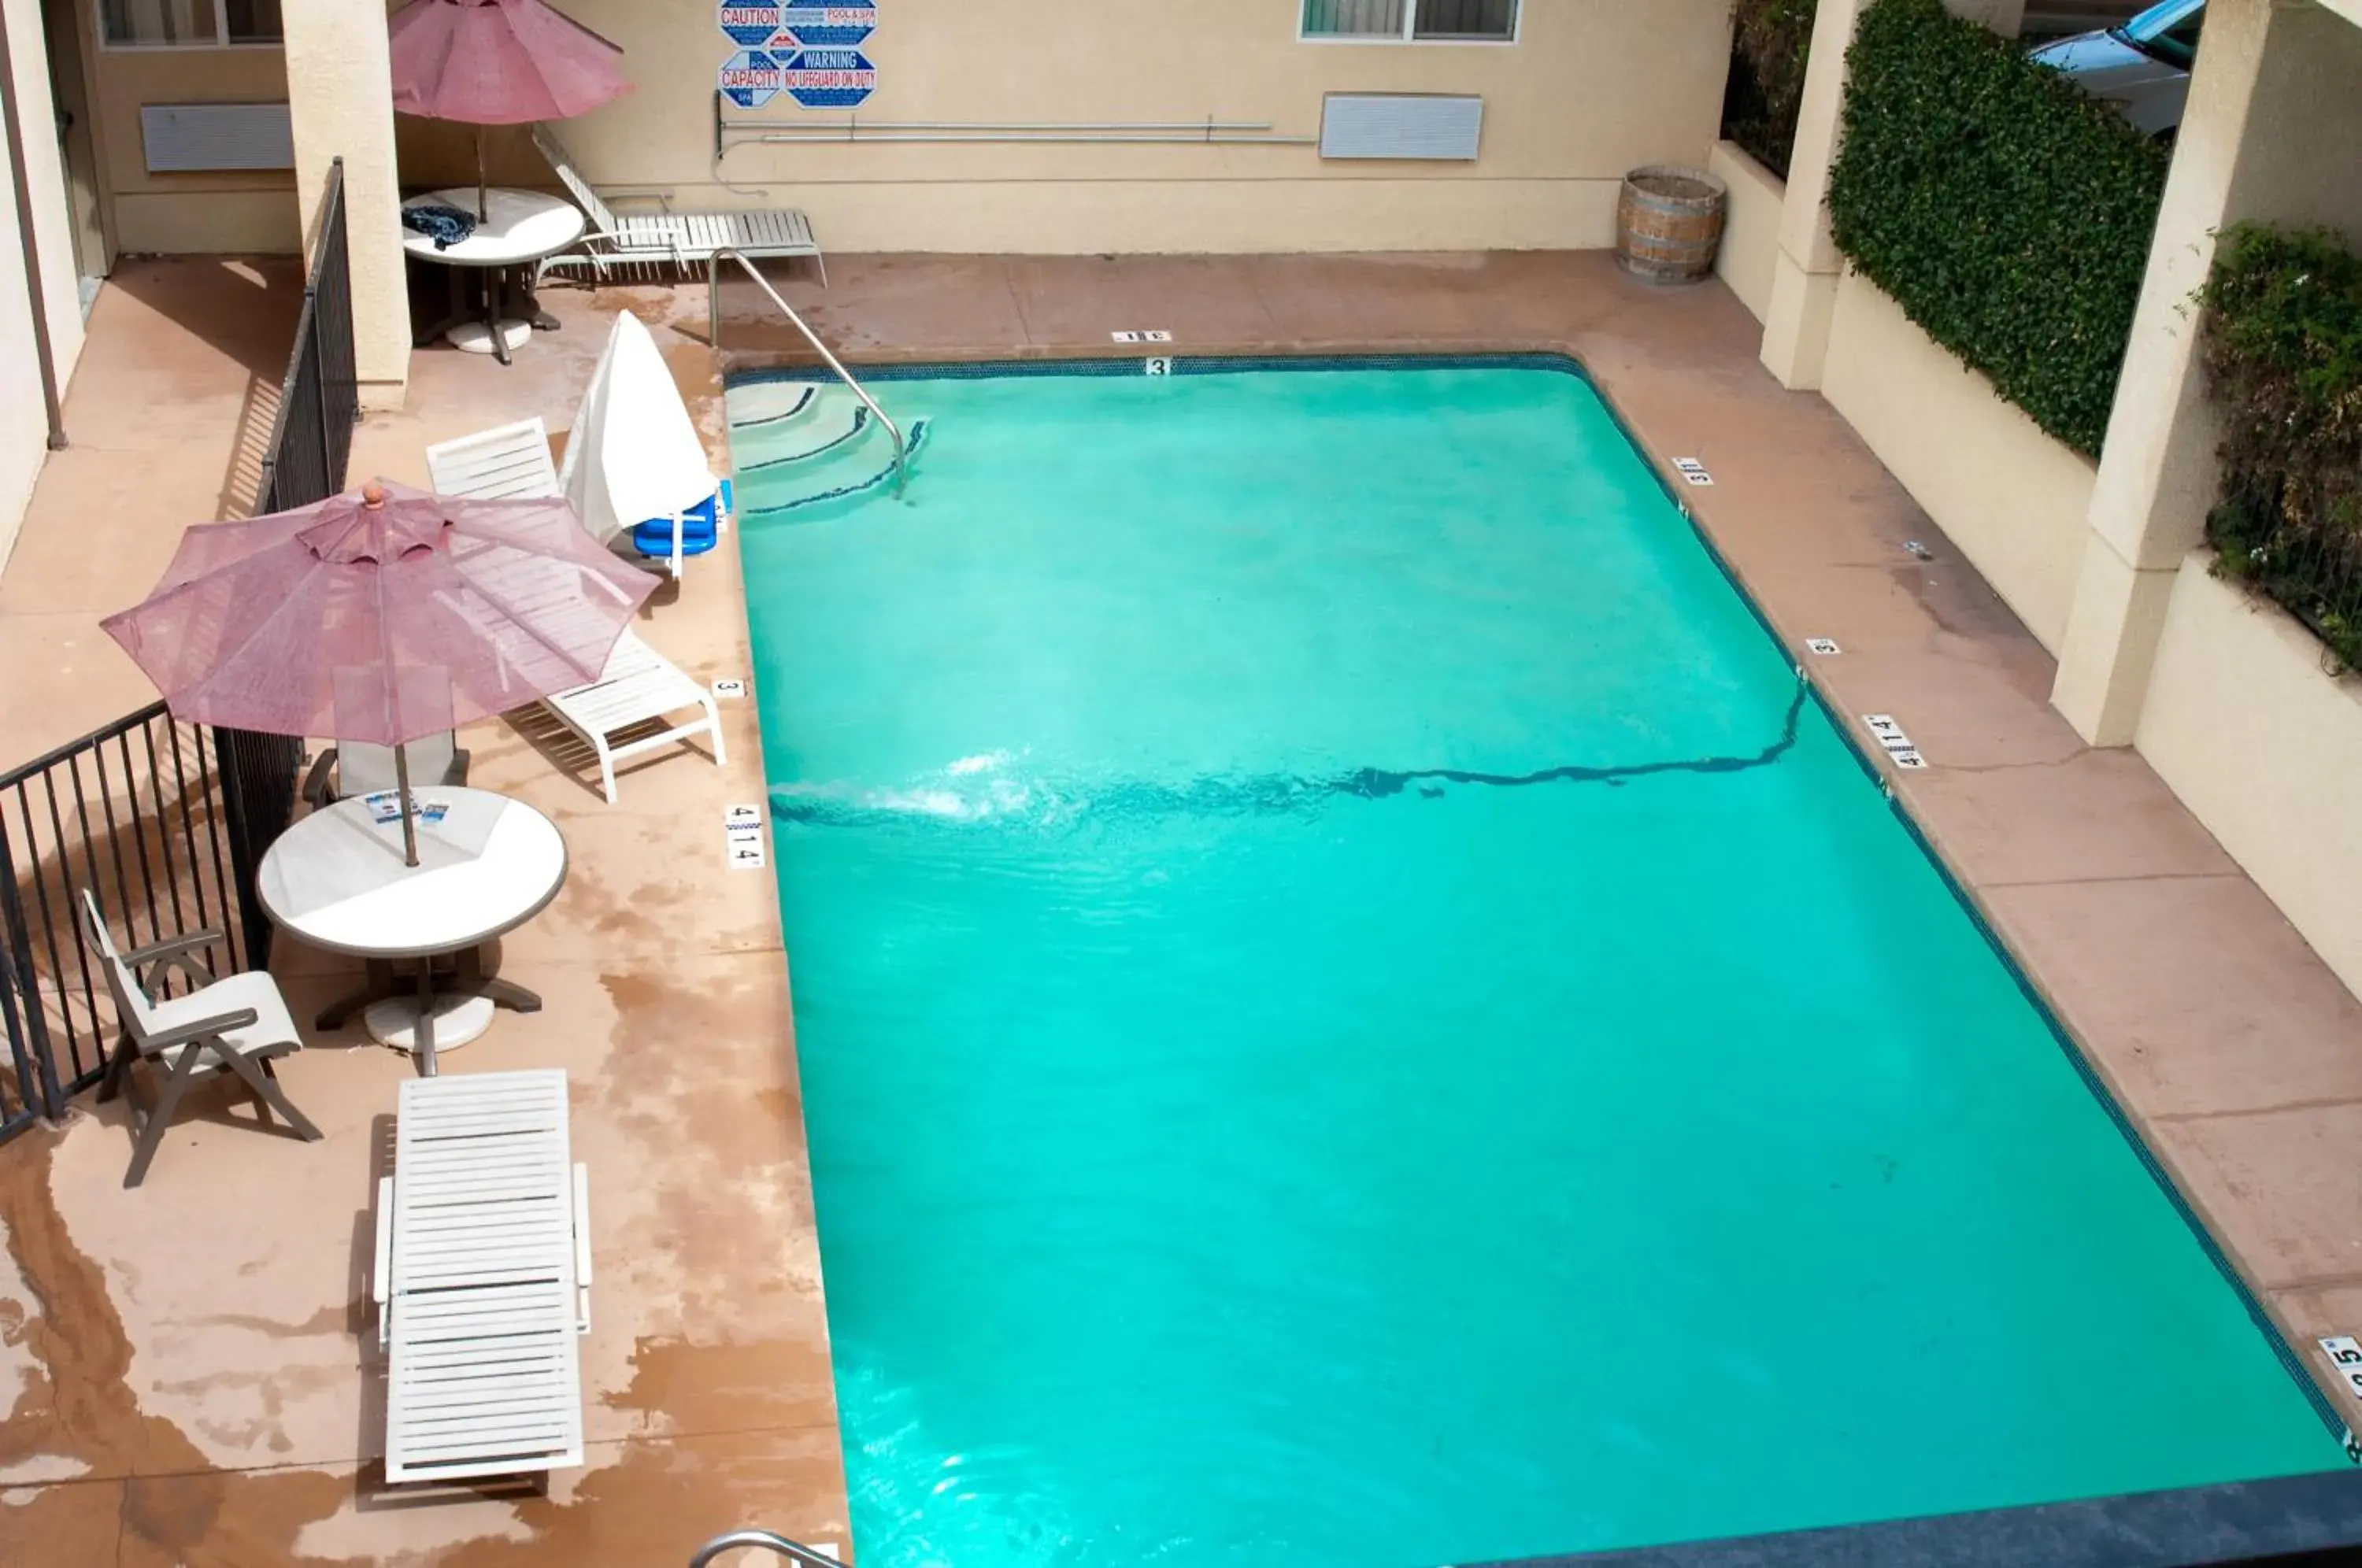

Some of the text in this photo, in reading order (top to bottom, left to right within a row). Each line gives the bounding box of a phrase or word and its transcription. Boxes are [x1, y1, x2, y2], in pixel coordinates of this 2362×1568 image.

[721, 9, 779, 24] CAUTION
[804, 52, 857, 69] WARNING
[722, 71, 780, 87] CAPACITY
[786, 72, 876, 87] NO LIFEGUARD ON DUTY
[1151, 360, 1165, 375] 3
